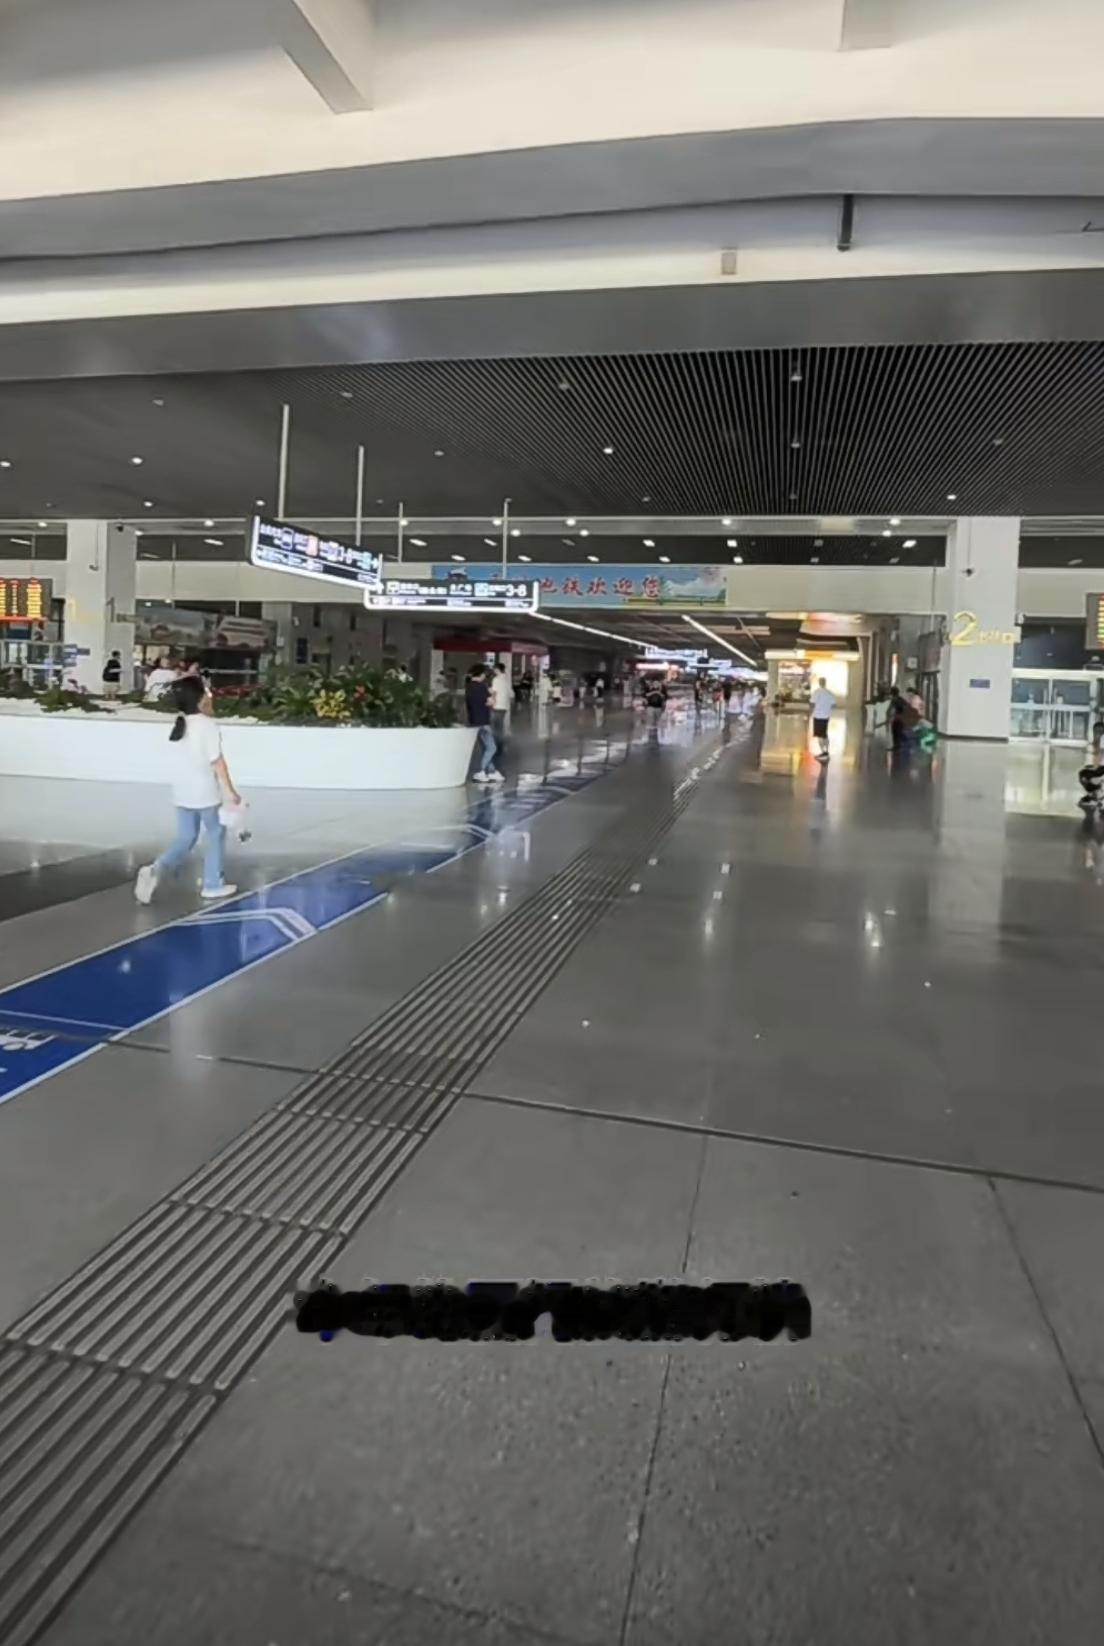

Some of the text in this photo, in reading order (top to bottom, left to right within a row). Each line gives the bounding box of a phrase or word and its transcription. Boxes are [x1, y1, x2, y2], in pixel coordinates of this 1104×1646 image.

[491, 573, 662, 598] 地铁欢迎您
[950, 610, 976, 646] 2
